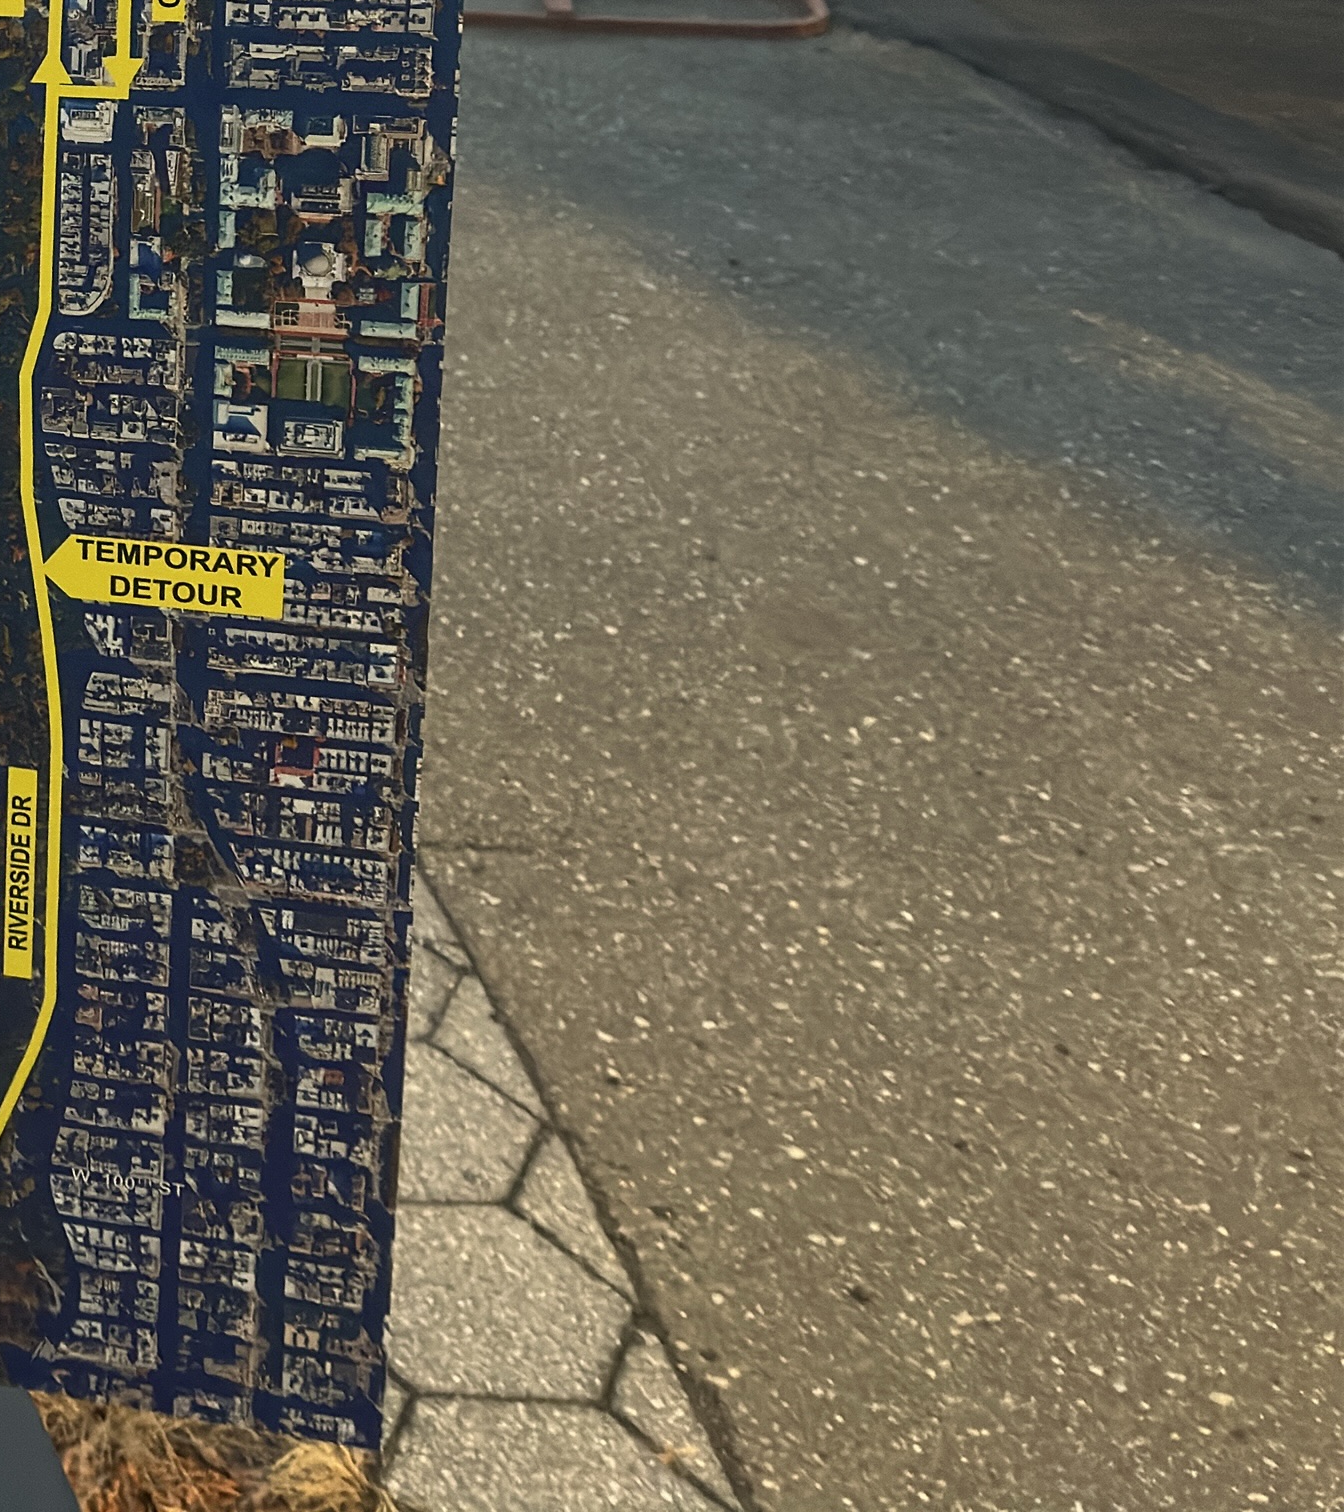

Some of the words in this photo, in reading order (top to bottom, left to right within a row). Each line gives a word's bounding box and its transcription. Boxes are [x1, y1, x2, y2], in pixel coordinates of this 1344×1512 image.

[75, 538, 280, 578] TEMPORARY
[109, 574, 243, 609] DETOUR
[11, 795, 32, 828] DR
[8, 833, 31, 951] RIVERSIDE
[159, 1181, 186, 1198] ST
